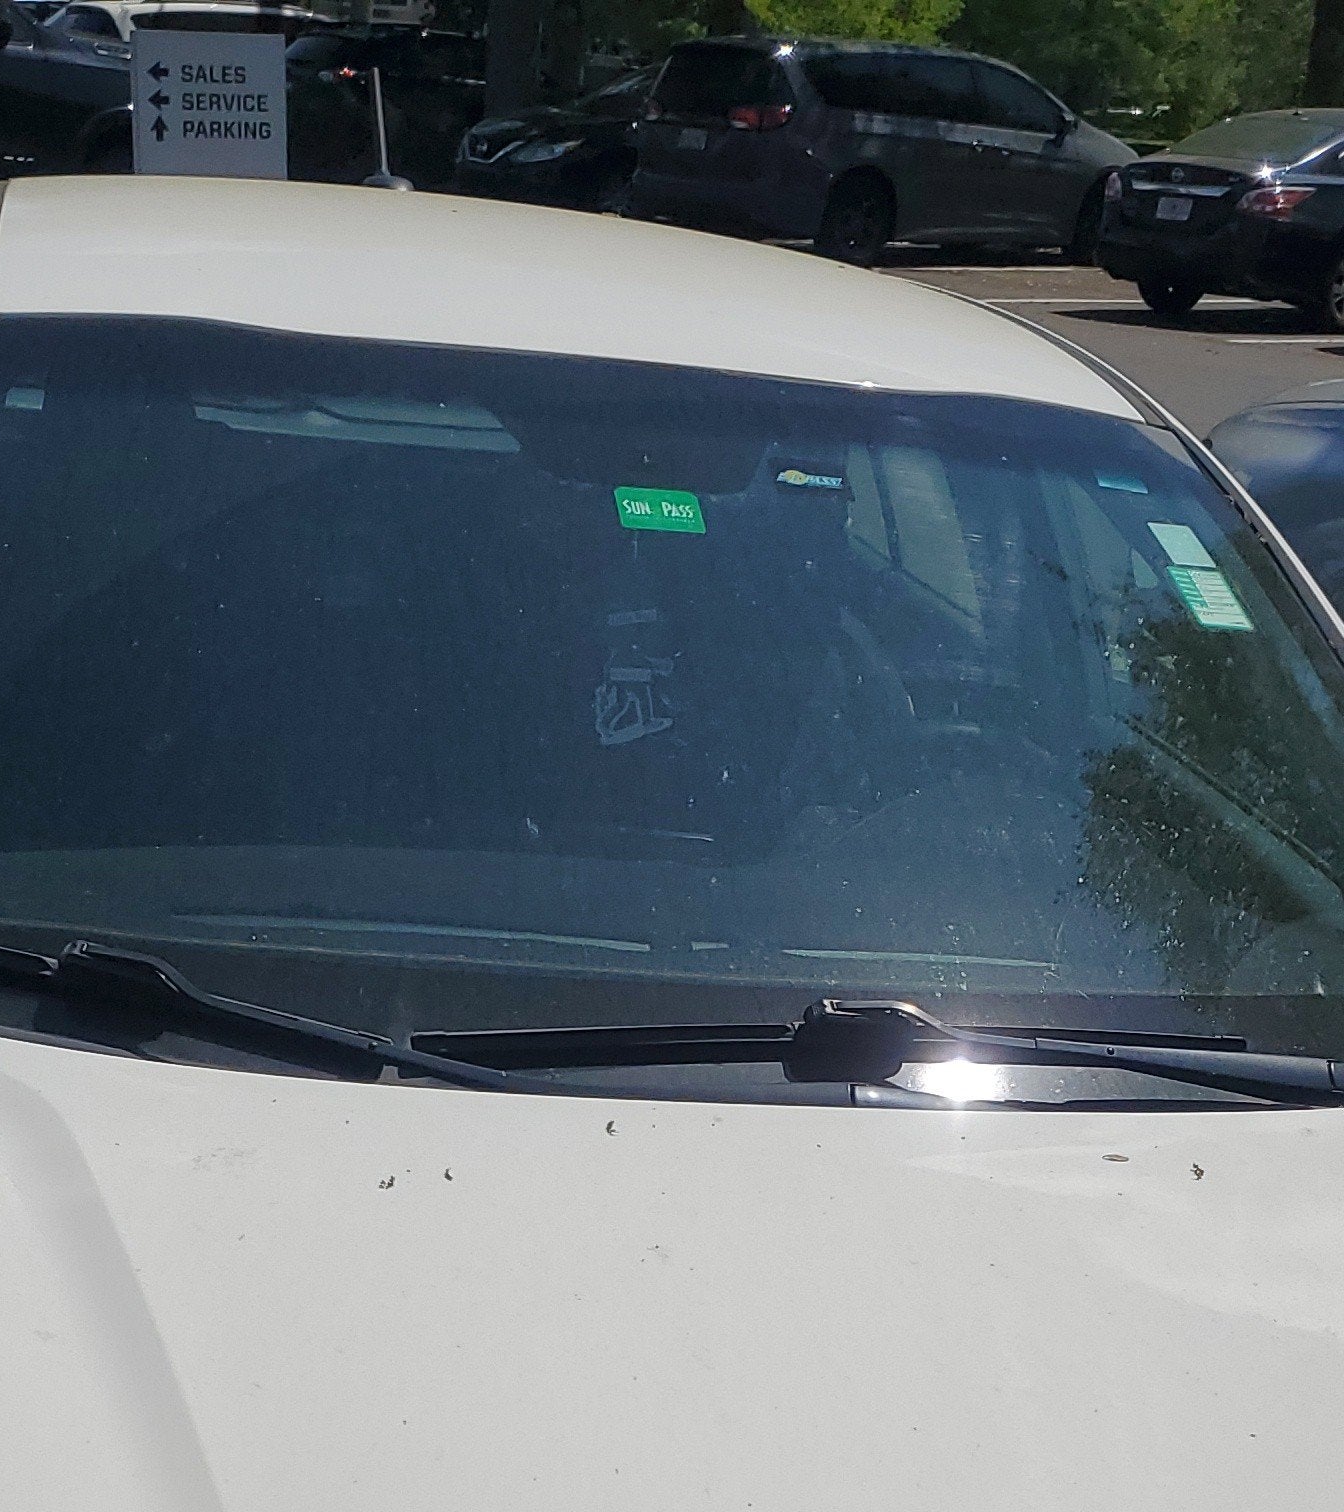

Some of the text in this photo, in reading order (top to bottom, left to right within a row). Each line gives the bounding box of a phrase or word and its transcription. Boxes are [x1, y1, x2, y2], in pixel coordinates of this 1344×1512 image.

[180, 64, 246, 84] SALES
[181, 92, 270, 112] SERVICE
[182, 120, 272, 140] PARKING
[622, 499, 694, 518] SUN PASS
